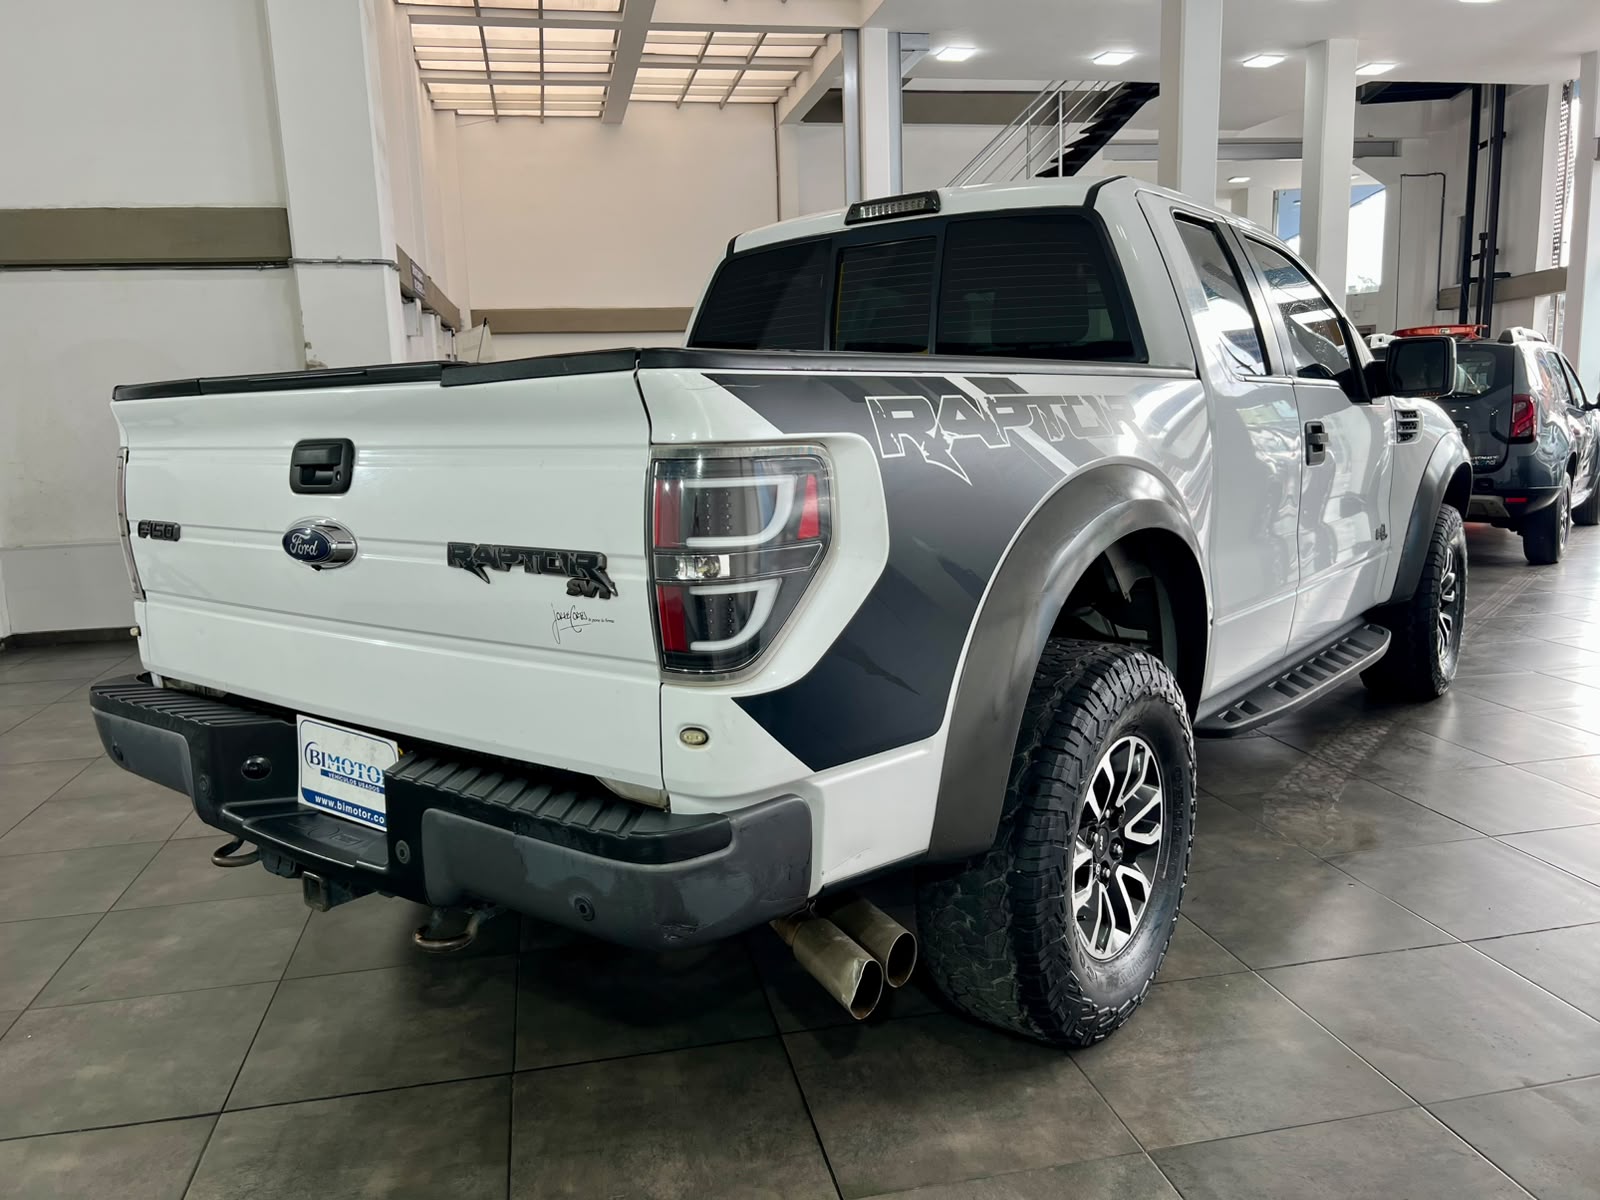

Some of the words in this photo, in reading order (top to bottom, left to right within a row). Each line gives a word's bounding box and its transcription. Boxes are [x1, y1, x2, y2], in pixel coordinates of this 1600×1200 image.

[865, 394, 1146, 486] RAPTOR
[290, 533, 318, 556] Ford
[447, 541, 618, 597] RAPTOR
[309, 748, 386, 785] BIMOTO
[315, 794, 385, 824] www.bimotor.co
